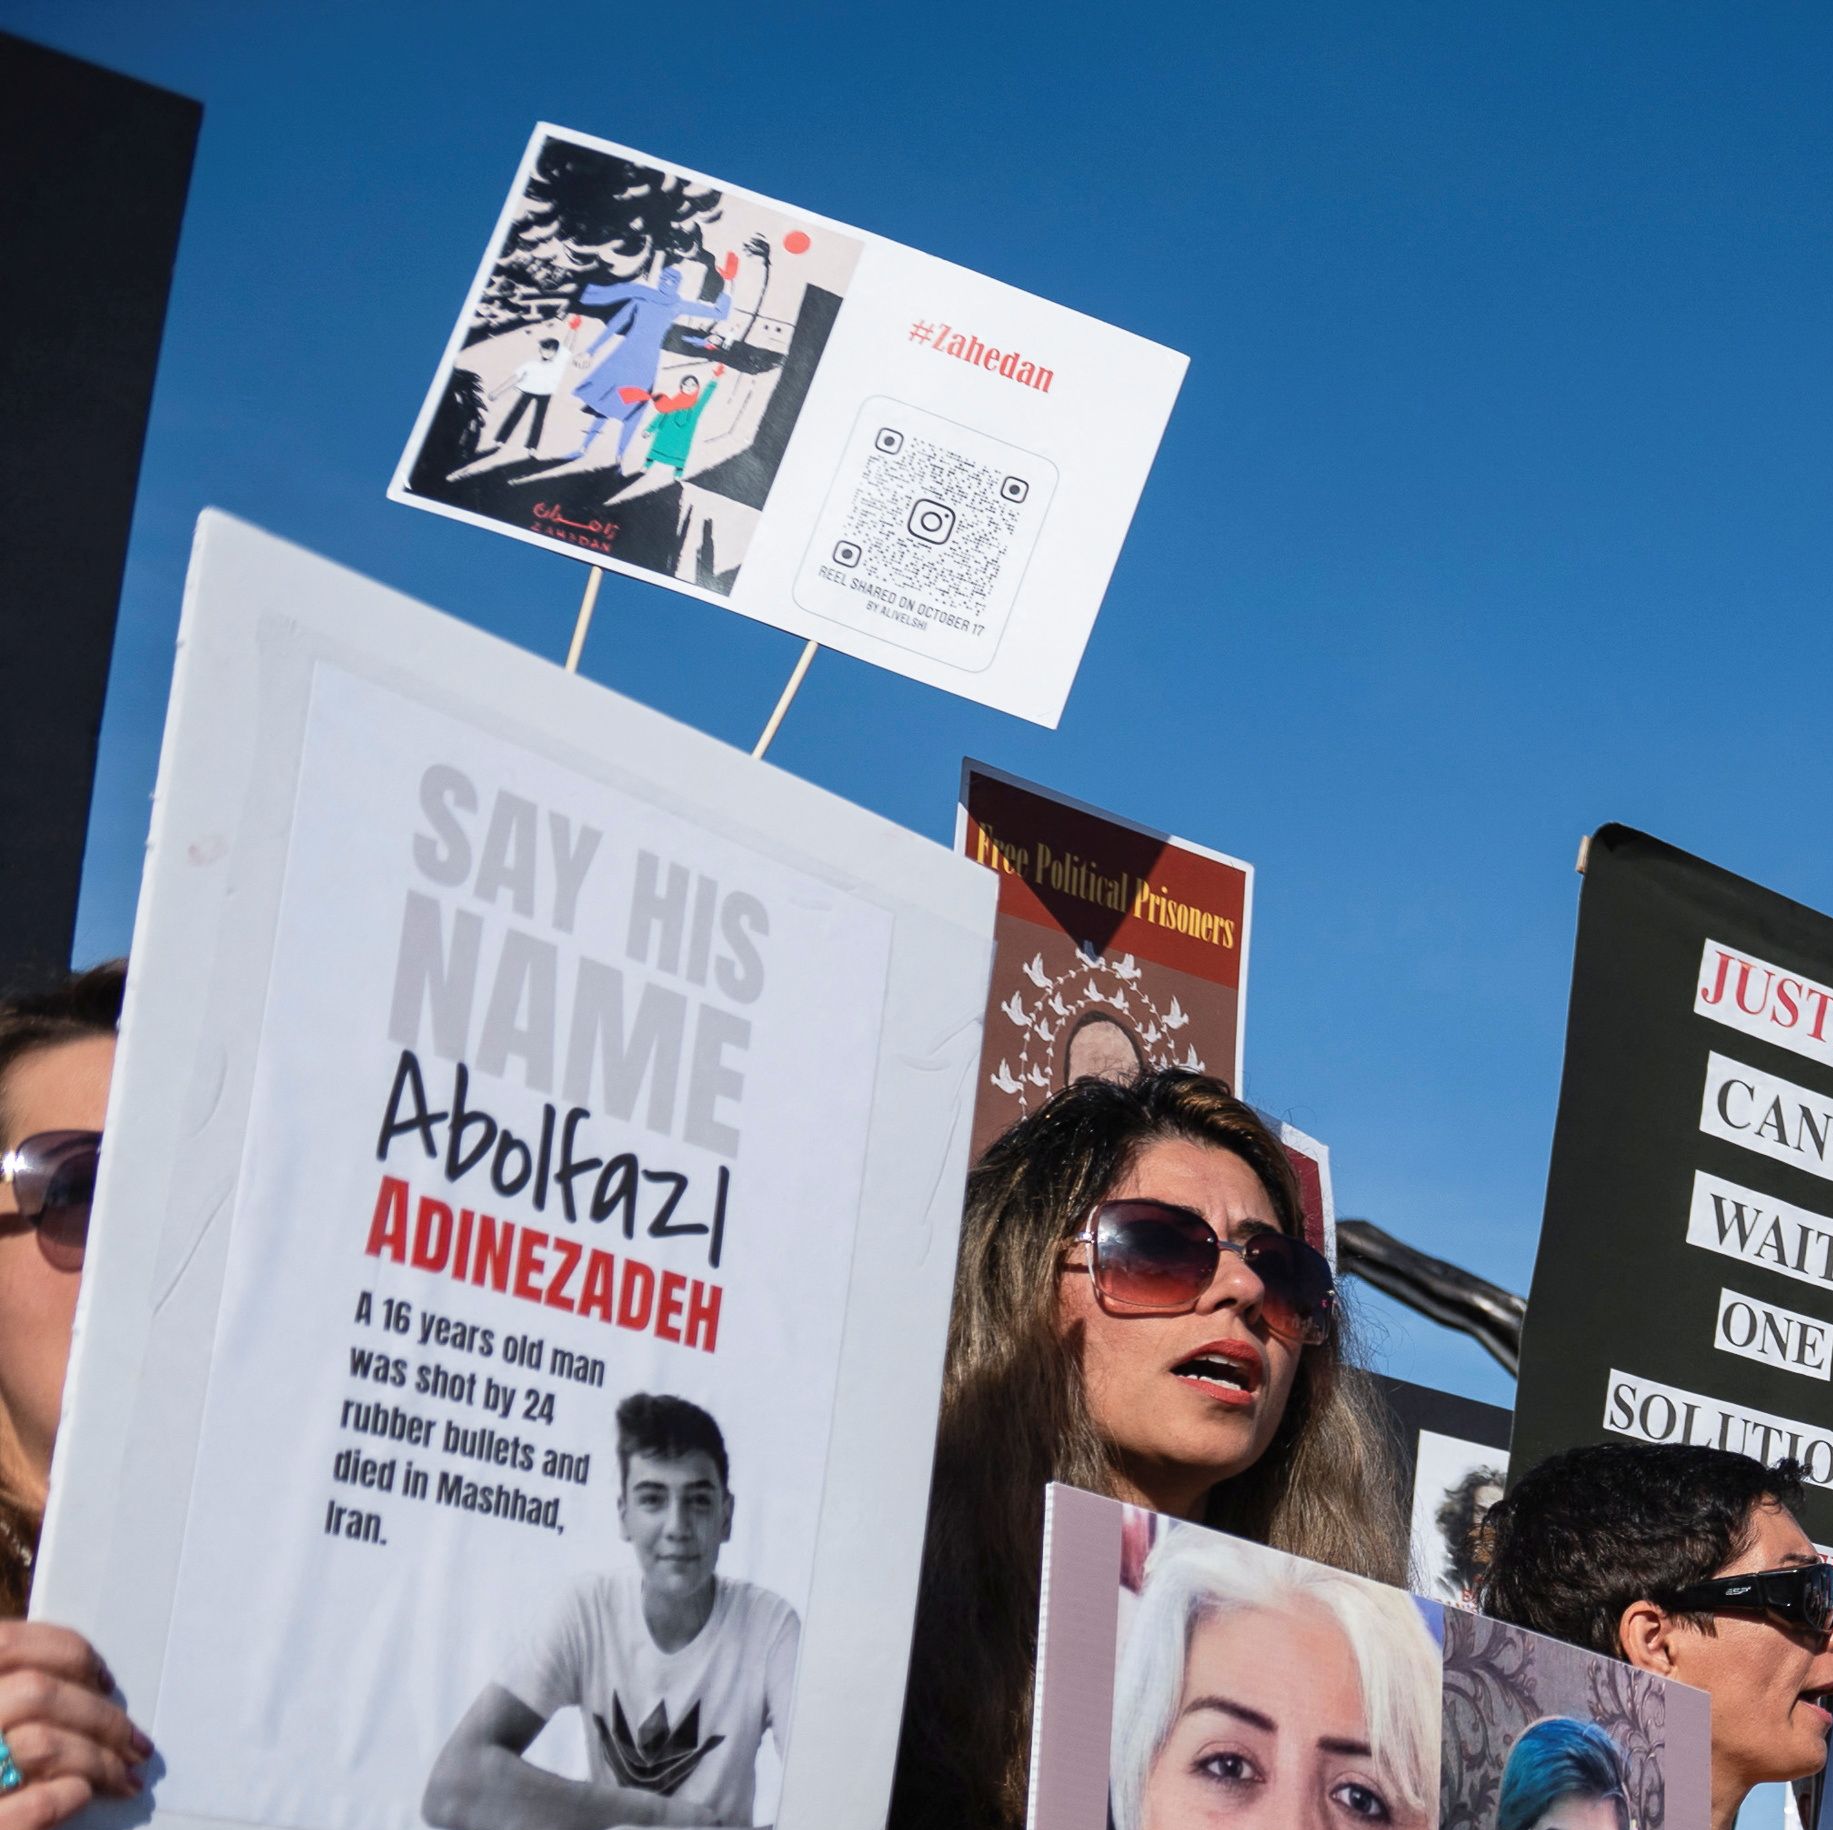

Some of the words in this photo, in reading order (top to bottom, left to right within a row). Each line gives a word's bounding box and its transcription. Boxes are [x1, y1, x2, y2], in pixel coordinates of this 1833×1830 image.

[908, 319, 1055, 394] #Zahedan
[817, 564, 852, 592] REEL
[850, 573, 897, 605] SHARED
[898, 596, 916, 612] ON
[916, 603, 970, 633] OCTOBER
[971, 623, 986, 637] 17
[866, 600, 880, 612] BY
[412, 763, 604, 936] SAY
[625, 847, 771, 1006] HIS
[976, 822, 1030, 878] Free
[1034, 842, 1128, 914] Political
[1132, 877, 1235, 950] Prisoners
[387, 887, 752, 1160] NAME
[375, 1048, 731, 1269] Abolfazl
[364, 1173, 723, 1354] ADINEZADEH
[354, 1290, 374, 1327] A
[382, 1297, 411, 1336] 16
[417, 1309, 496, 1358] years
[502, 1333, 544, 1371] old
[549, 1346, 606, 1388] man
[1721, 1300, 1827, 1371] ONE
[349, 1346, 408, 1388] was
[415, 1361, 477, 1407] shot
[484, 1376, 517, 1421] by
[522, 1387, 556, 1426] 24
[340, 1398, 437, 1448] rubber
[443, 1420, 535, 1472] bullets
[541, 1446, 591, 1486] and
[324, 1500, 388, 1547] Iran.
[332, 1448, 397, 1494] died
[402, 1461, 429, 1500] in
[436, 1471, 566, 1534] Mashhad,
